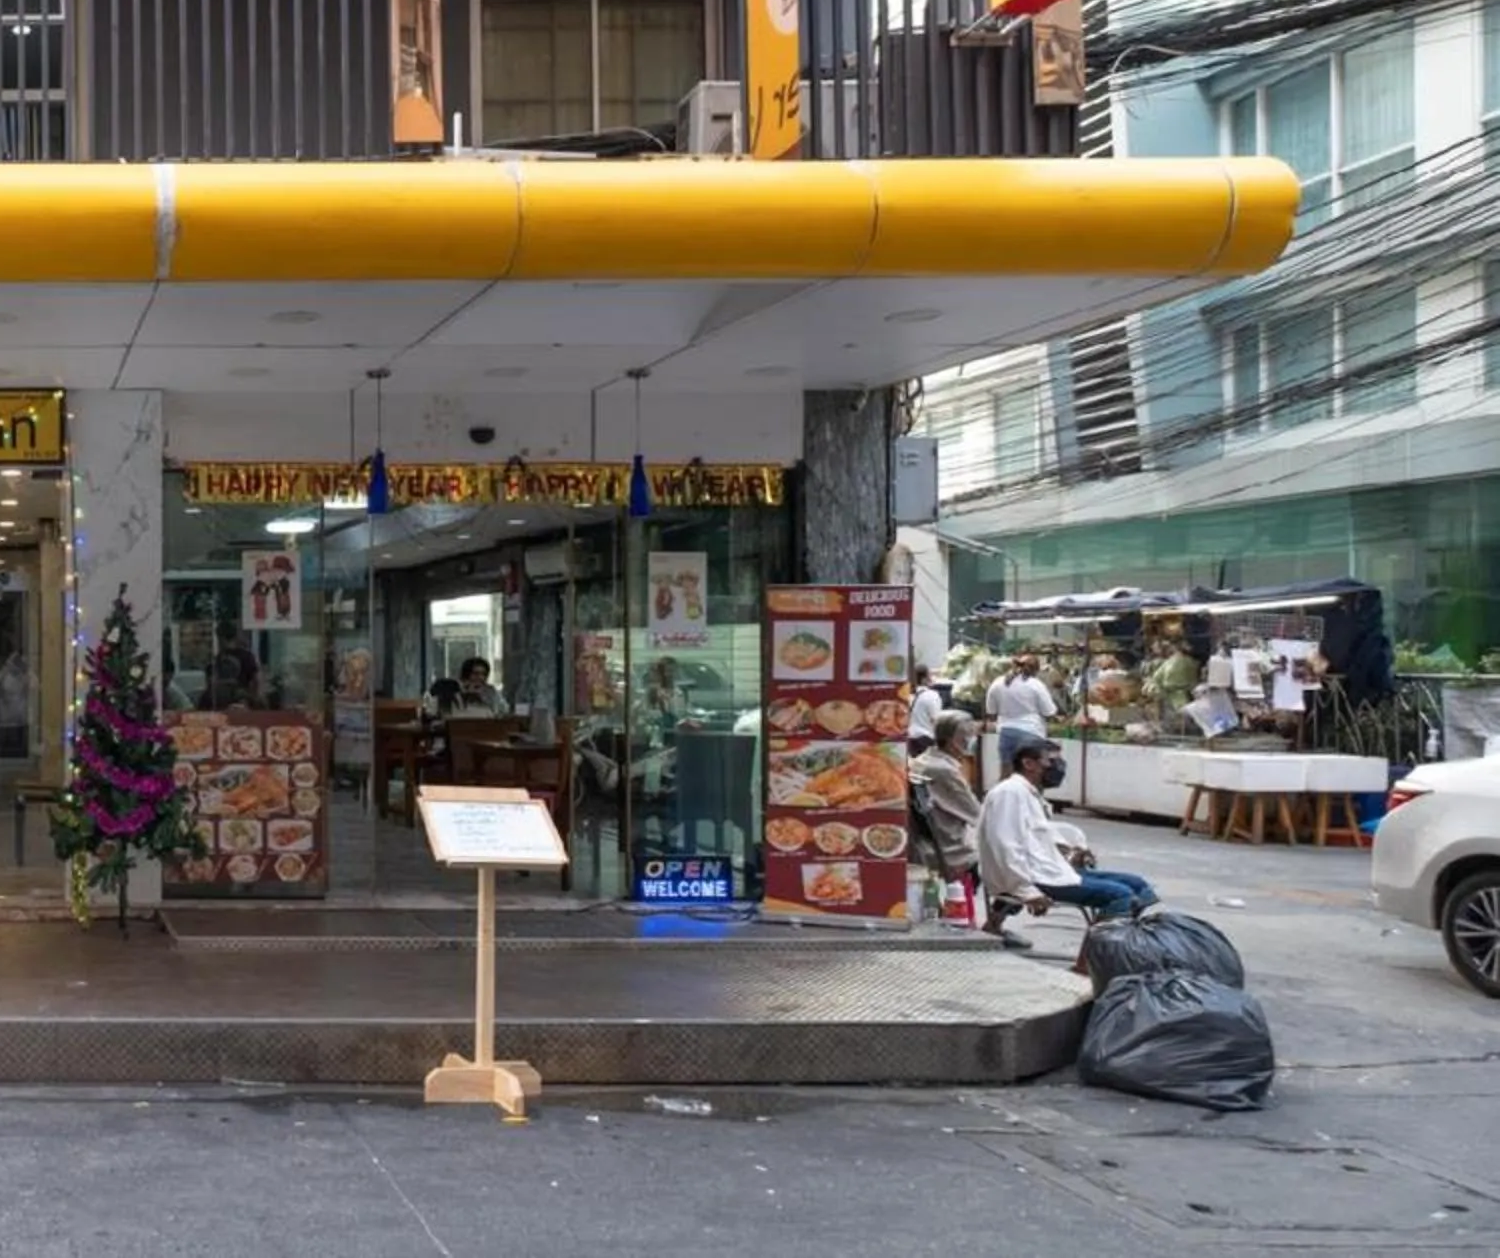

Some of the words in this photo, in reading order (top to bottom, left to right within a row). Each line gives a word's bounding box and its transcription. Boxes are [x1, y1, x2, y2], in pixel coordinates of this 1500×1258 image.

[207, 470, 299, 497] HAPPY
[389, 468, 463, 496] YEAR
[863, 604, 896, 619] FOOD
[644, 860, 722, 879] OPEN
[642, 880, 728, 898] WELCOME
